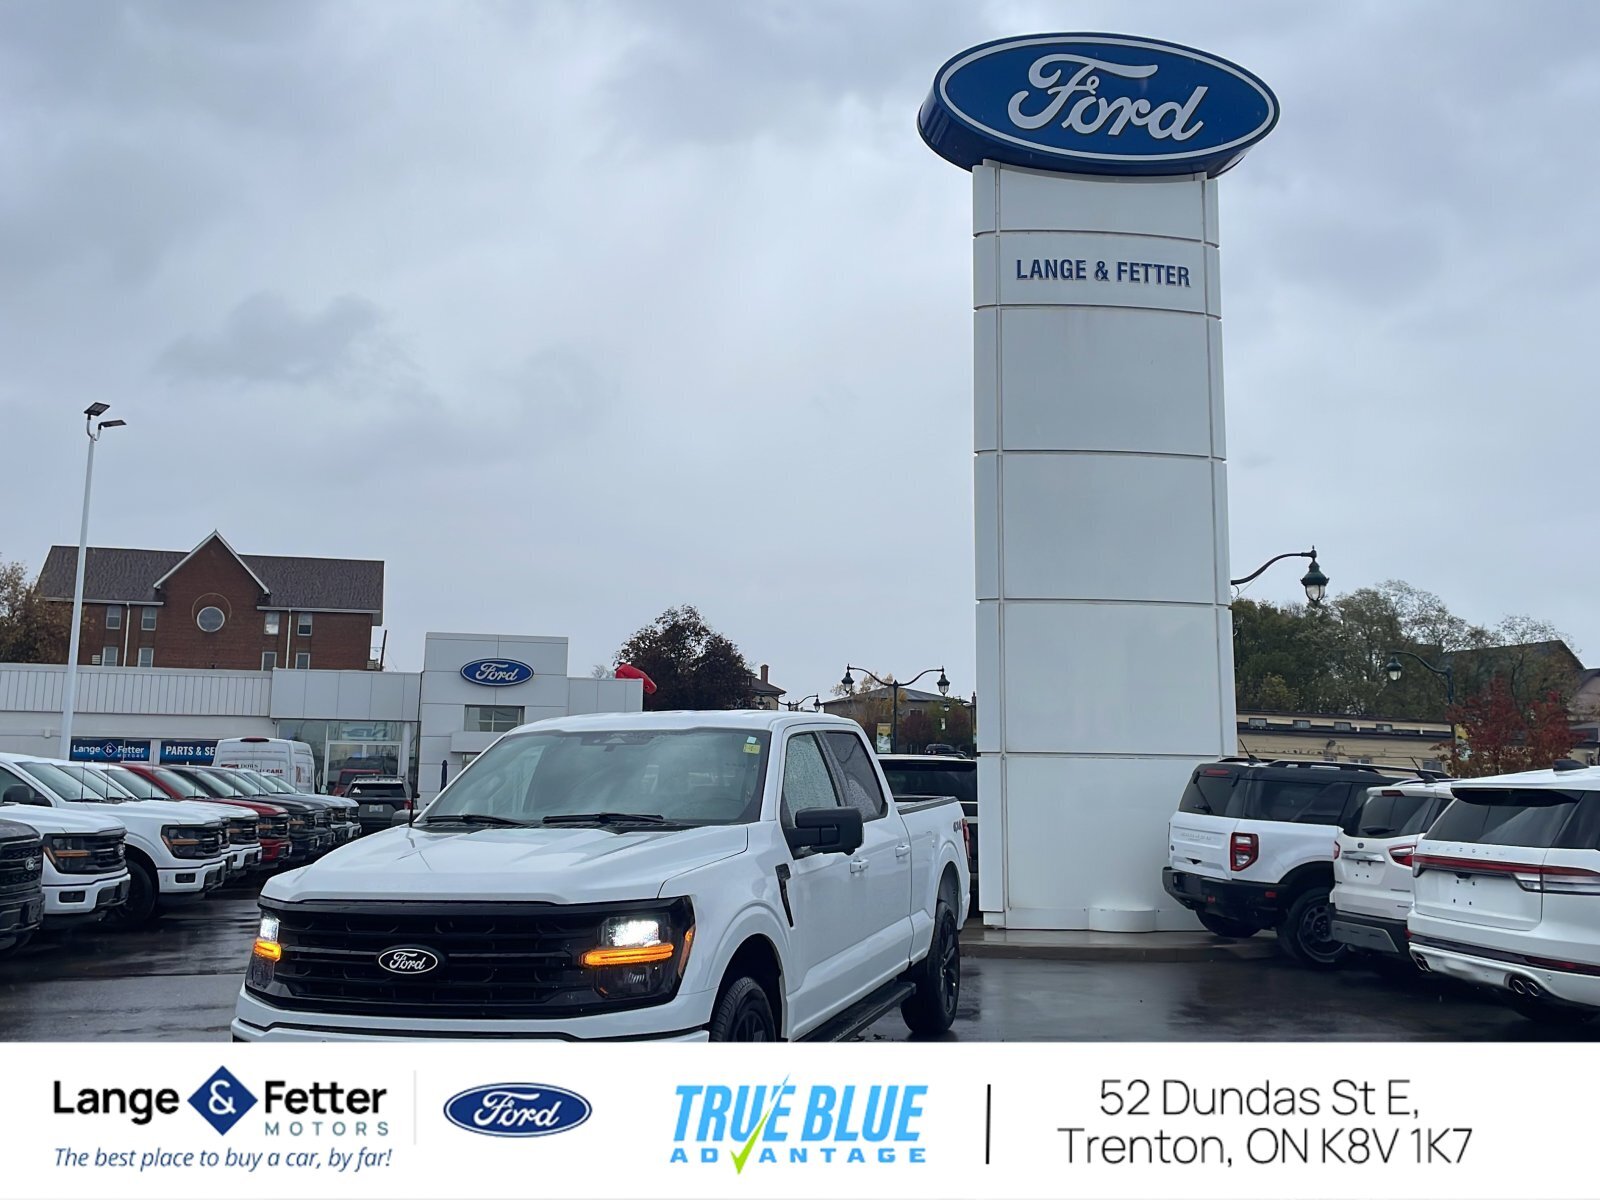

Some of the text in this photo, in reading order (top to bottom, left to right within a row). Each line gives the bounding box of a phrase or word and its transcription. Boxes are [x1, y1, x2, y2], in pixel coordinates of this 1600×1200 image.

[1008, 53, 1208, 141] Ford
[1015, 258, 1191, 288] LANGE & FETTER
[475, 662, 520, 681] Ford
[73, 744, 100, 755] Lange
[117, 745, 145, 754] Fetter
[165, 746, 216, 756] PARTS & SE
[389, 951, 427, 970] Ford
